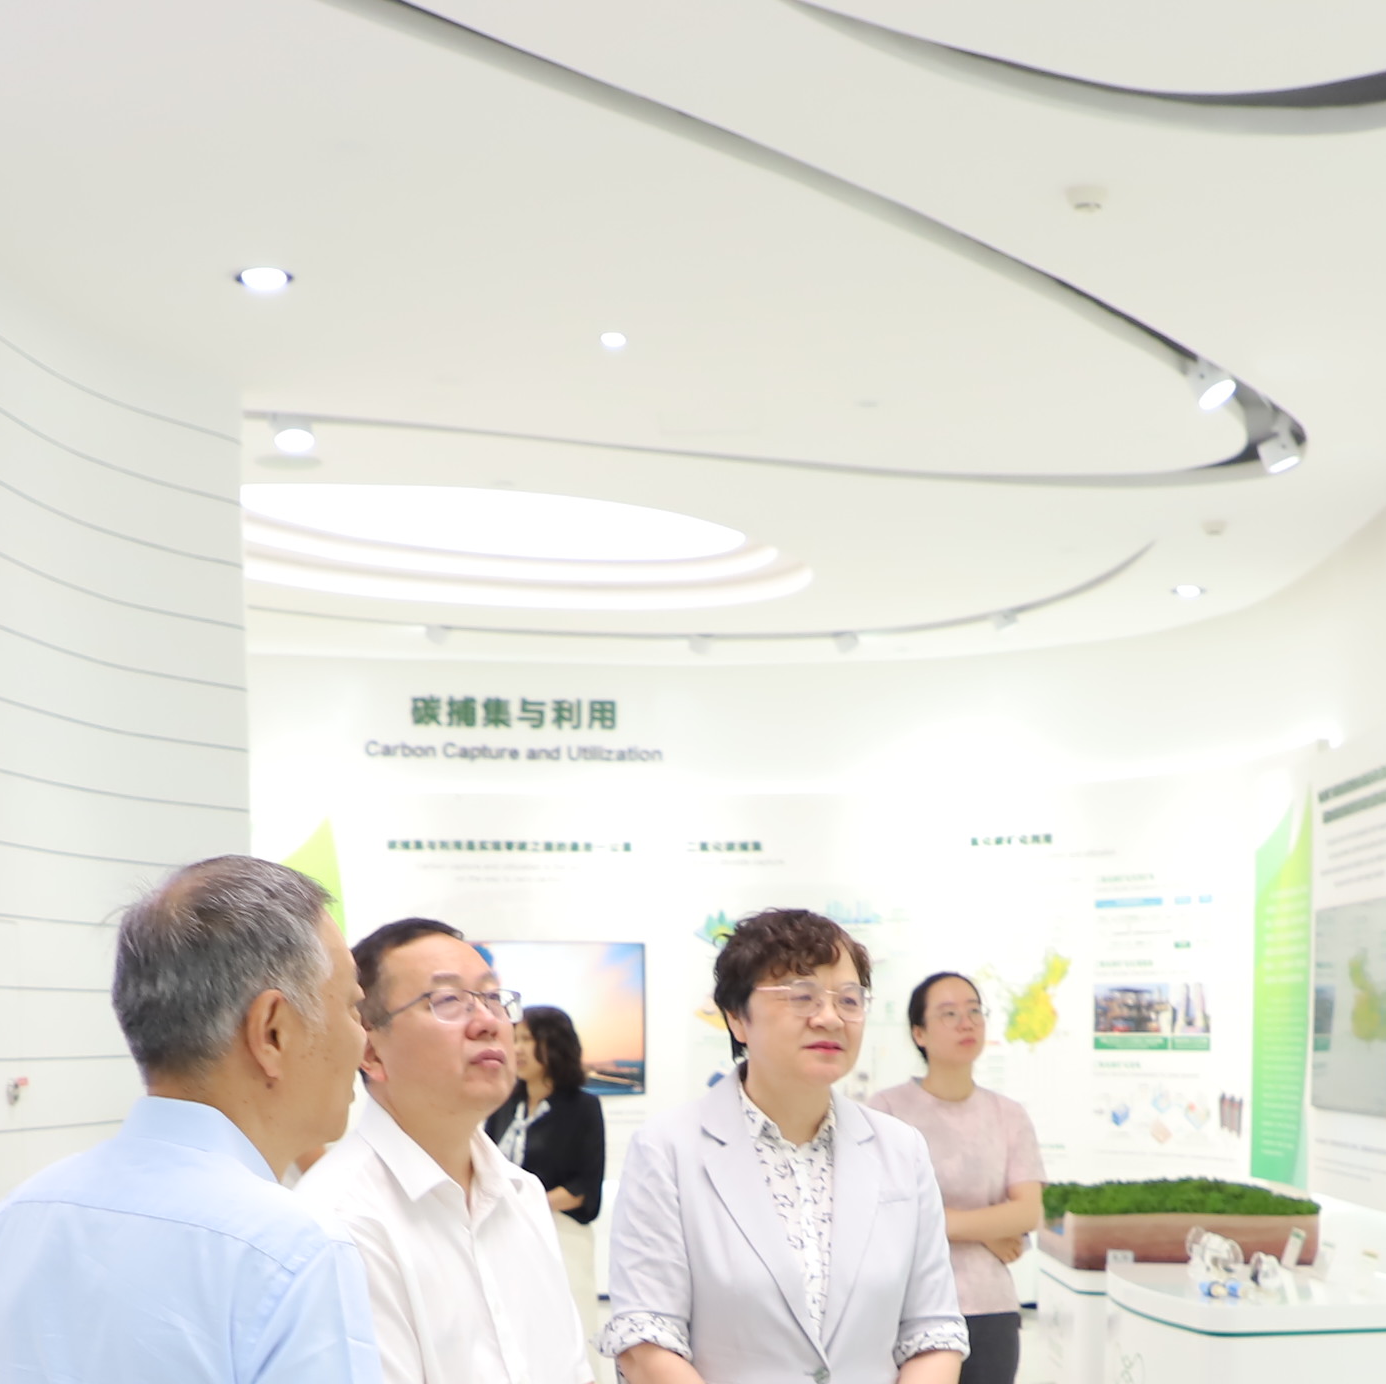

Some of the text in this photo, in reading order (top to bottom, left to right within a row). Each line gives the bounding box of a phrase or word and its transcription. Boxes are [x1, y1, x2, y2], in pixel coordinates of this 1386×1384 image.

[410, 694, 618, 731] 碳捕集与利用
[365, 740, 664, 762] Carbon Capture and Utilization
